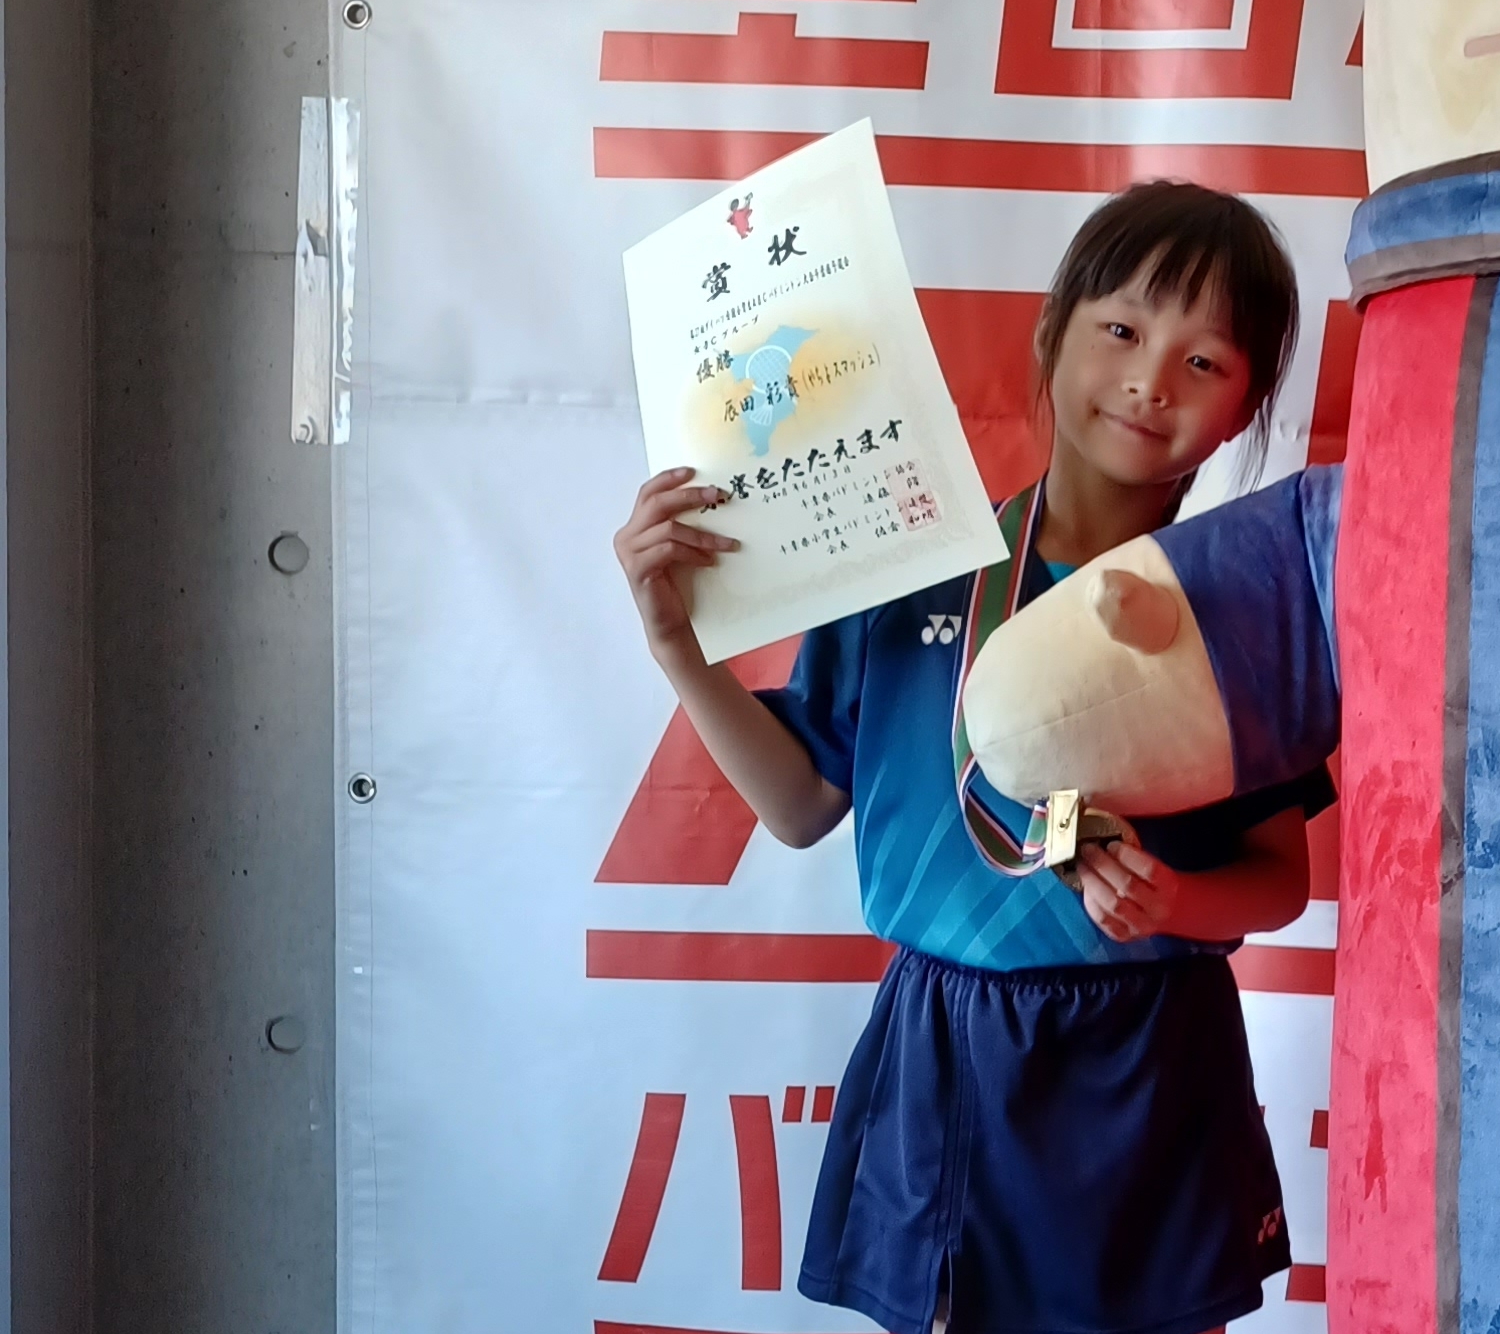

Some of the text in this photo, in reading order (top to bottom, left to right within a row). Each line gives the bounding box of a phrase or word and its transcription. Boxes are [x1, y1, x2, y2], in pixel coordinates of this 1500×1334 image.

[695, 349, 735, 384] 優勝
[700, 417, 903, 514] 誉をたたえます
